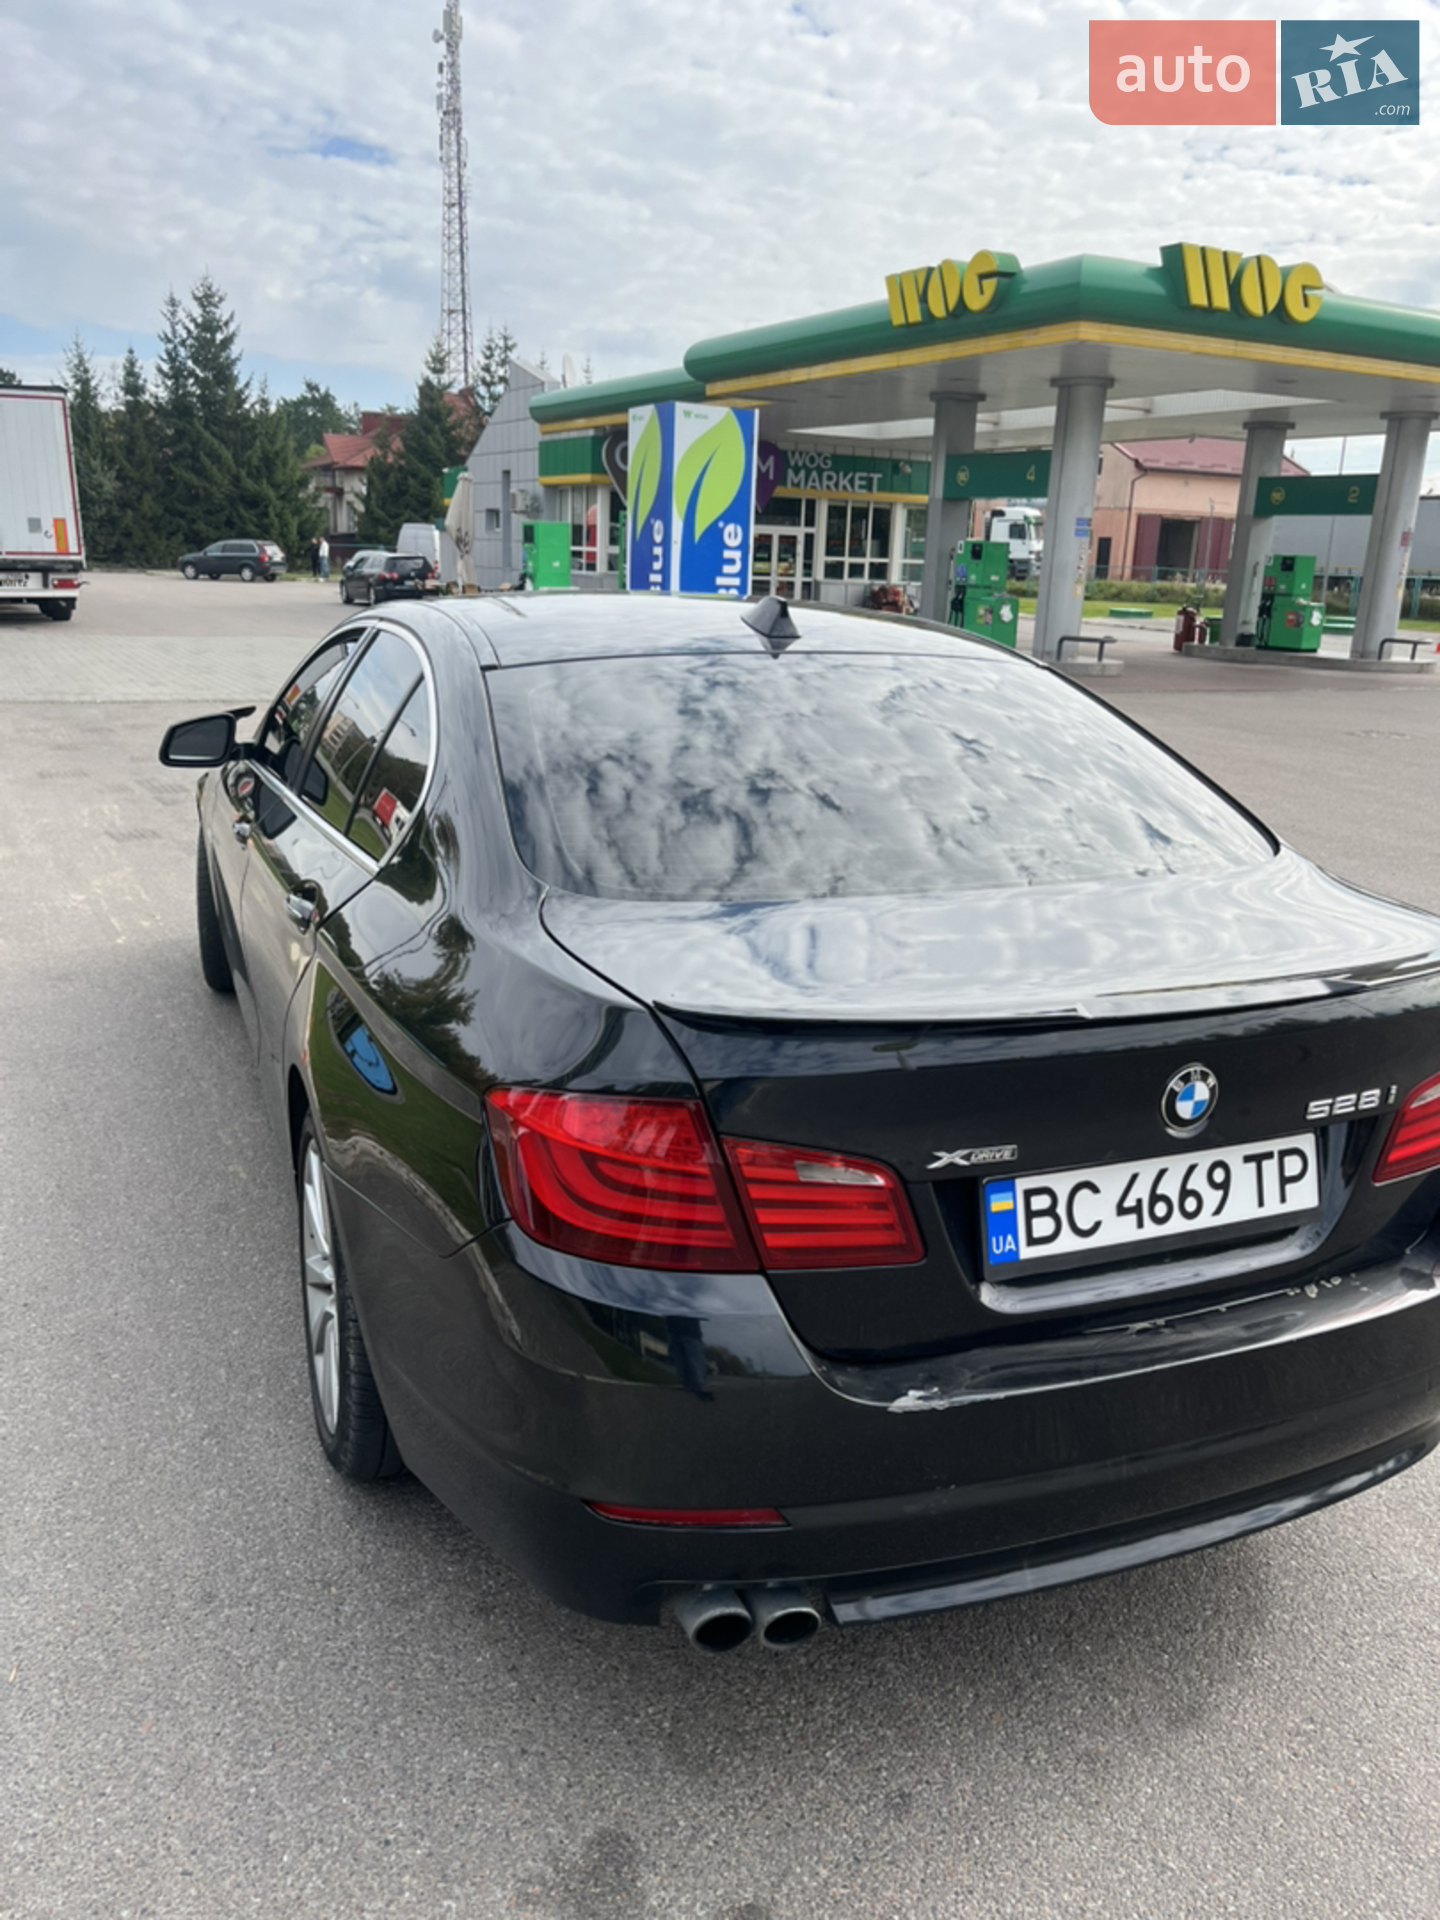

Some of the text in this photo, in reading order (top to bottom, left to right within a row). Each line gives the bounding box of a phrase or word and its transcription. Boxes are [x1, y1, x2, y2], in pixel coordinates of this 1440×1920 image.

[885, 249, 998, 327] WOG
[1181, 242, 1324, 323] WOG
[787, 451, 832, 470] WOG
[786, 469, 882, 495] MARKET
[1026, 465, 1035, 484] 4
[1347, 486, 1360, 503] 2
[1172, 1068, 1216, 1092] BMW
[1022, 1147, 1310, 1248] BC 4669 TP
[991, 1233, 1018, 1255] UA
